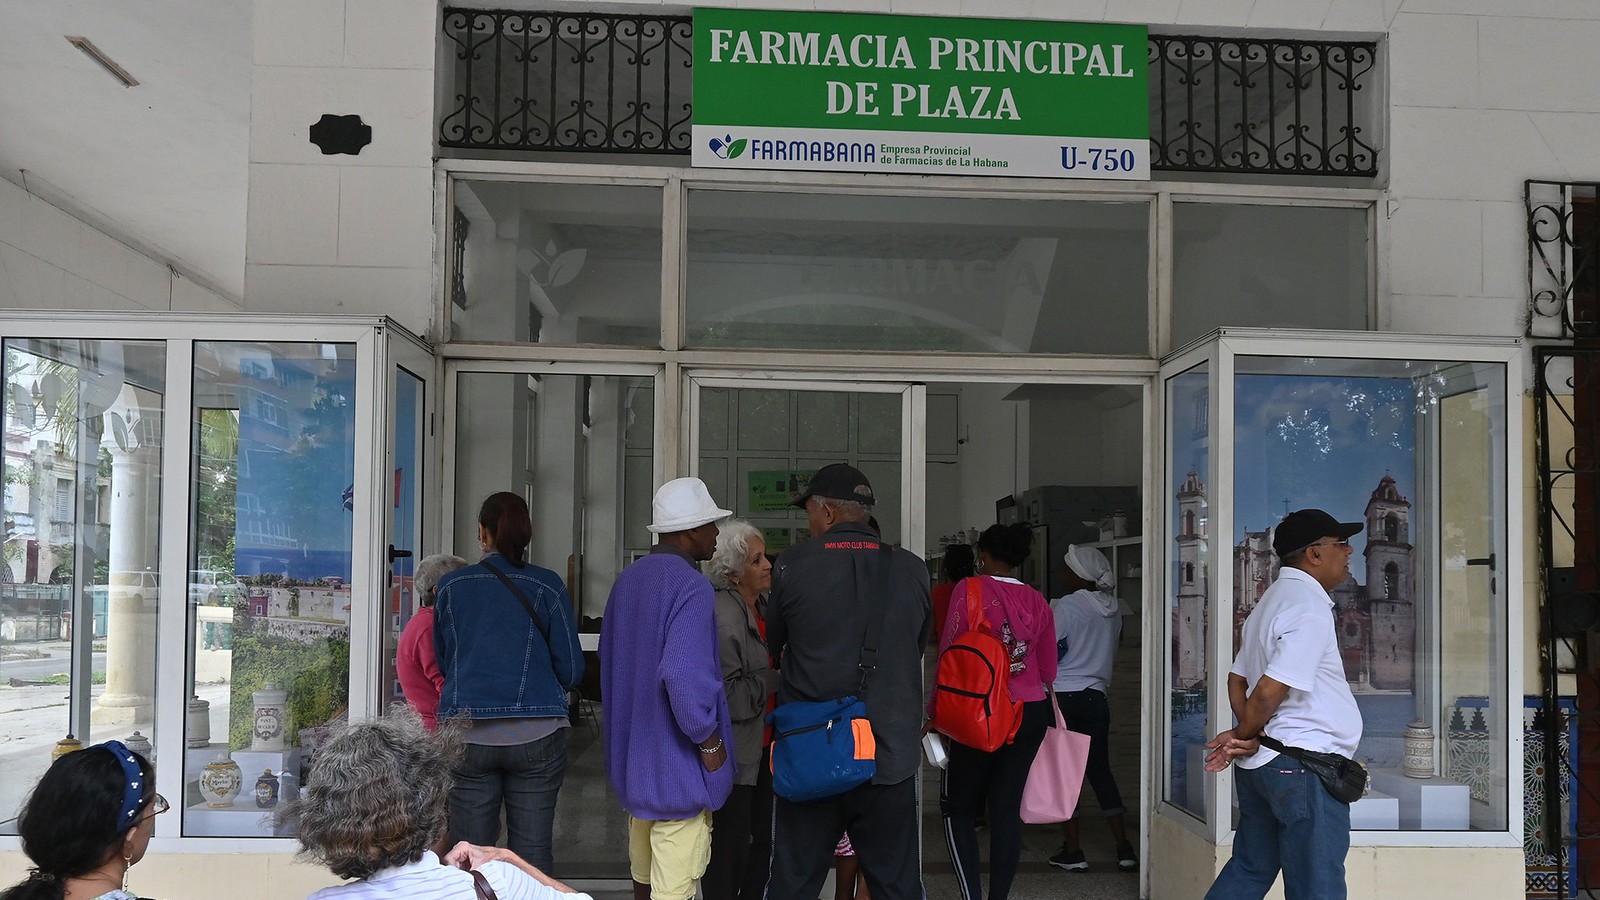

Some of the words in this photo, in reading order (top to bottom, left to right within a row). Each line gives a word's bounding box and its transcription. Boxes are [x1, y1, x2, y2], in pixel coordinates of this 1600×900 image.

[709, 28, 916, 70] FARMACIA
[929, 37, 1134, 78] PRINCIPAL
[826, 81, 880, 116] DE
[891, 84, 1021, 121] PLAZA
[751, 139, 875, 163] FARMABANA
[880, 144, 920, 155] Empresa
[923, 145, 971, 156] Provincial
[880, 155, 892, 165] de
[894, 156, 942, 167] Farmacias
[945, 157, 957, 167] de
[960, 157, 970, 167] La
[973, 158, 1009, 168] Habana
[1060, 146, 1135, 172] U-750
[851, 541, 862, 550] CLUB
